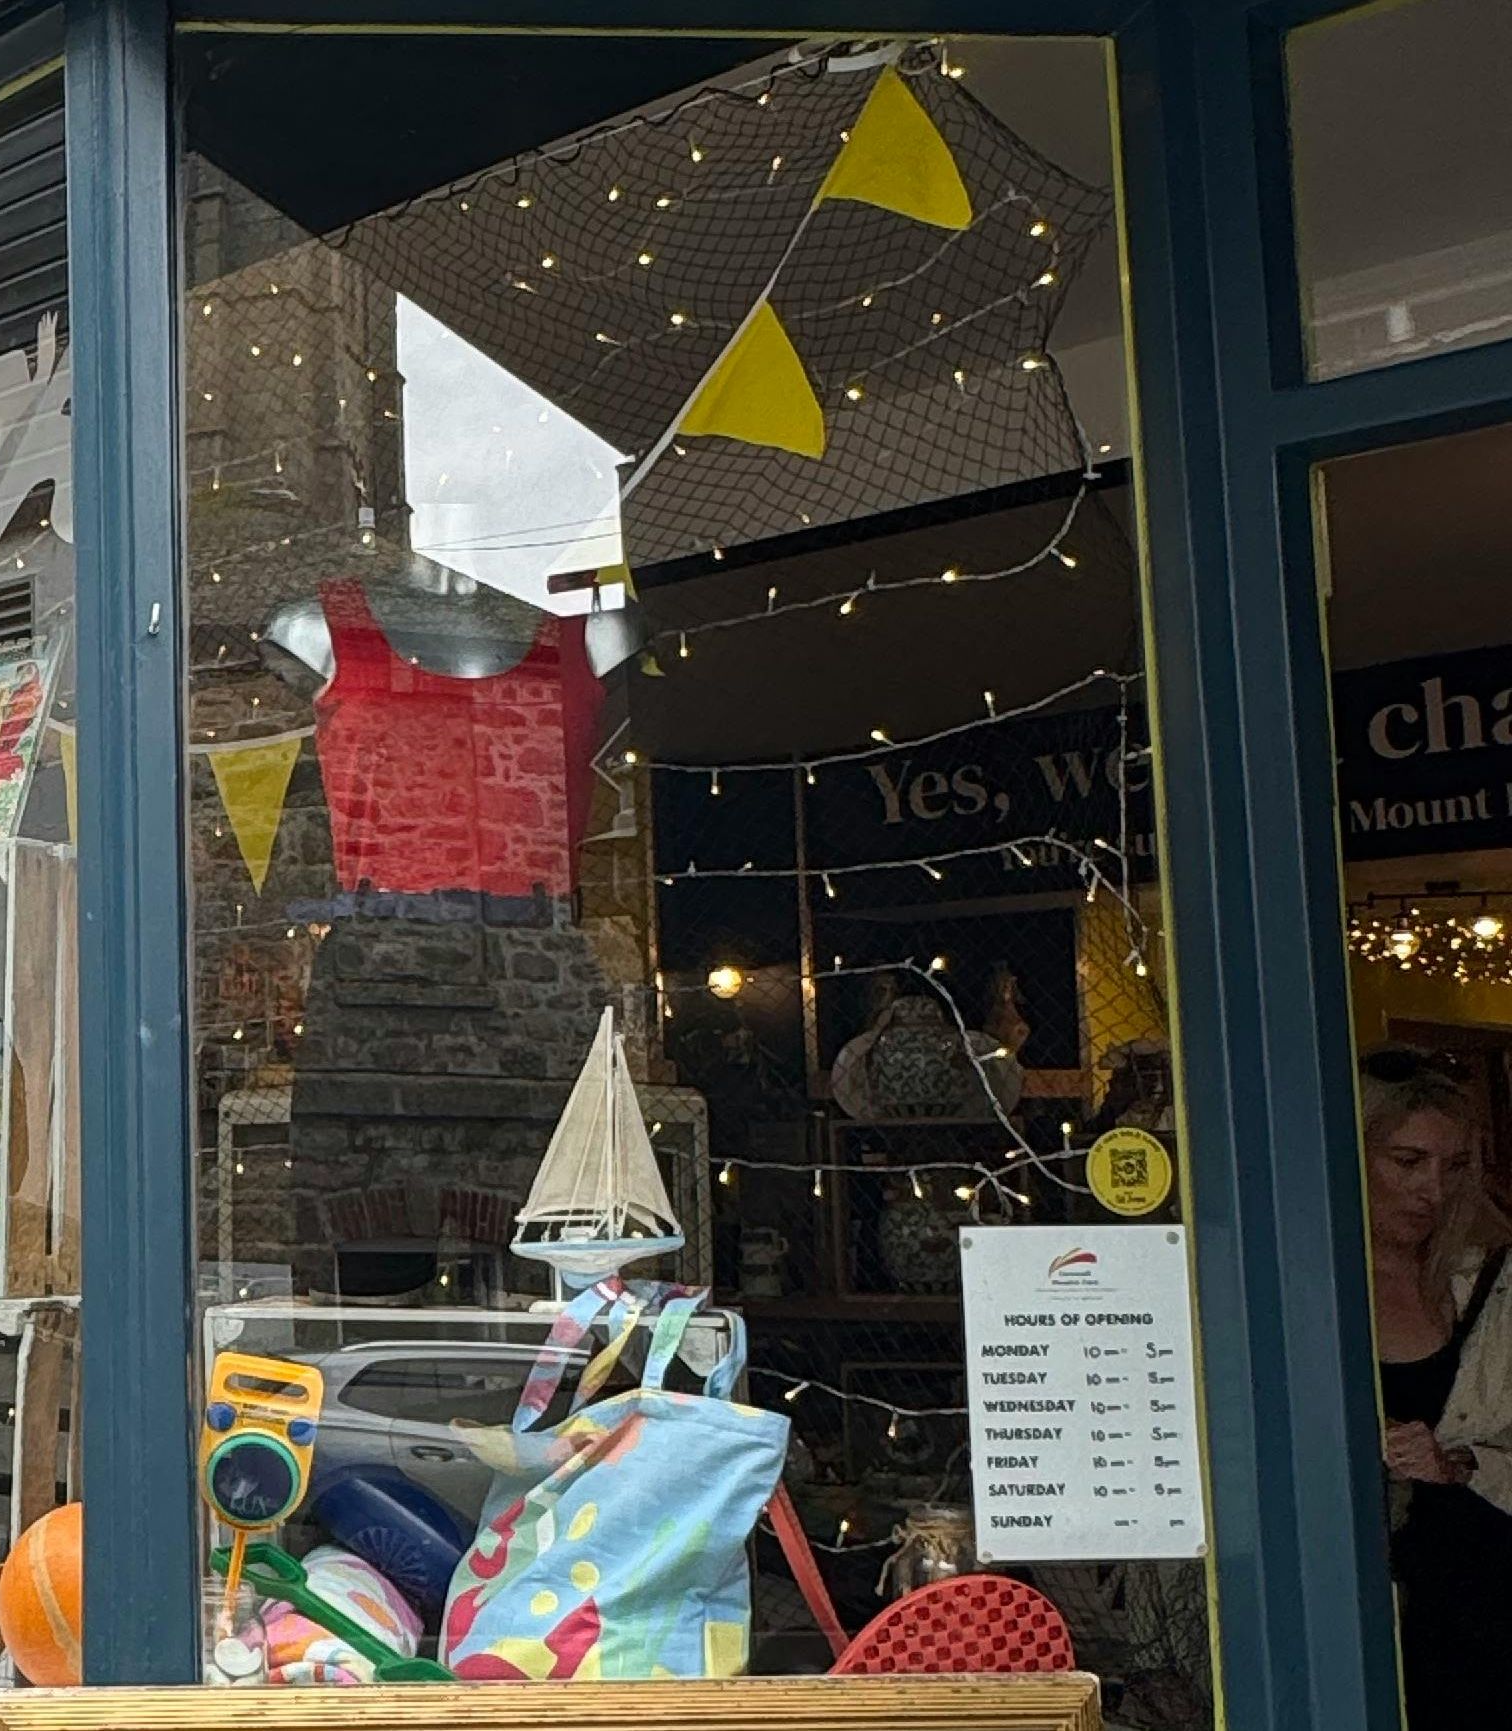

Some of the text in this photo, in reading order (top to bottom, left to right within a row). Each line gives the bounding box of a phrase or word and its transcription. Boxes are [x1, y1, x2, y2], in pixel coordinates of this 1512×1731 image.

[863, 758, 1011, 825] Yes,
[1348, 787, 1494, 834] Mount
[1004, 1312, 1154, 1327] HOURS OF OPENING
[980, 1343, 1050, 1358] MONDAY
[1083, 1345, 1102, 1359] 10
[981, 1371, 1048, 1385] TUESDAY
[982, 1399, 1076, 1413] WEDNESDAY
[984, 1427, 1063, 1441] THURSDAY
[986, 1455, 1039, 1469] FRIDAY
[988, 1482, 1066, 1497] SATURDAY
[1093, 1485, 1108, 1498] 10
[990, 1514, 1053, 1529] SUNDAY
